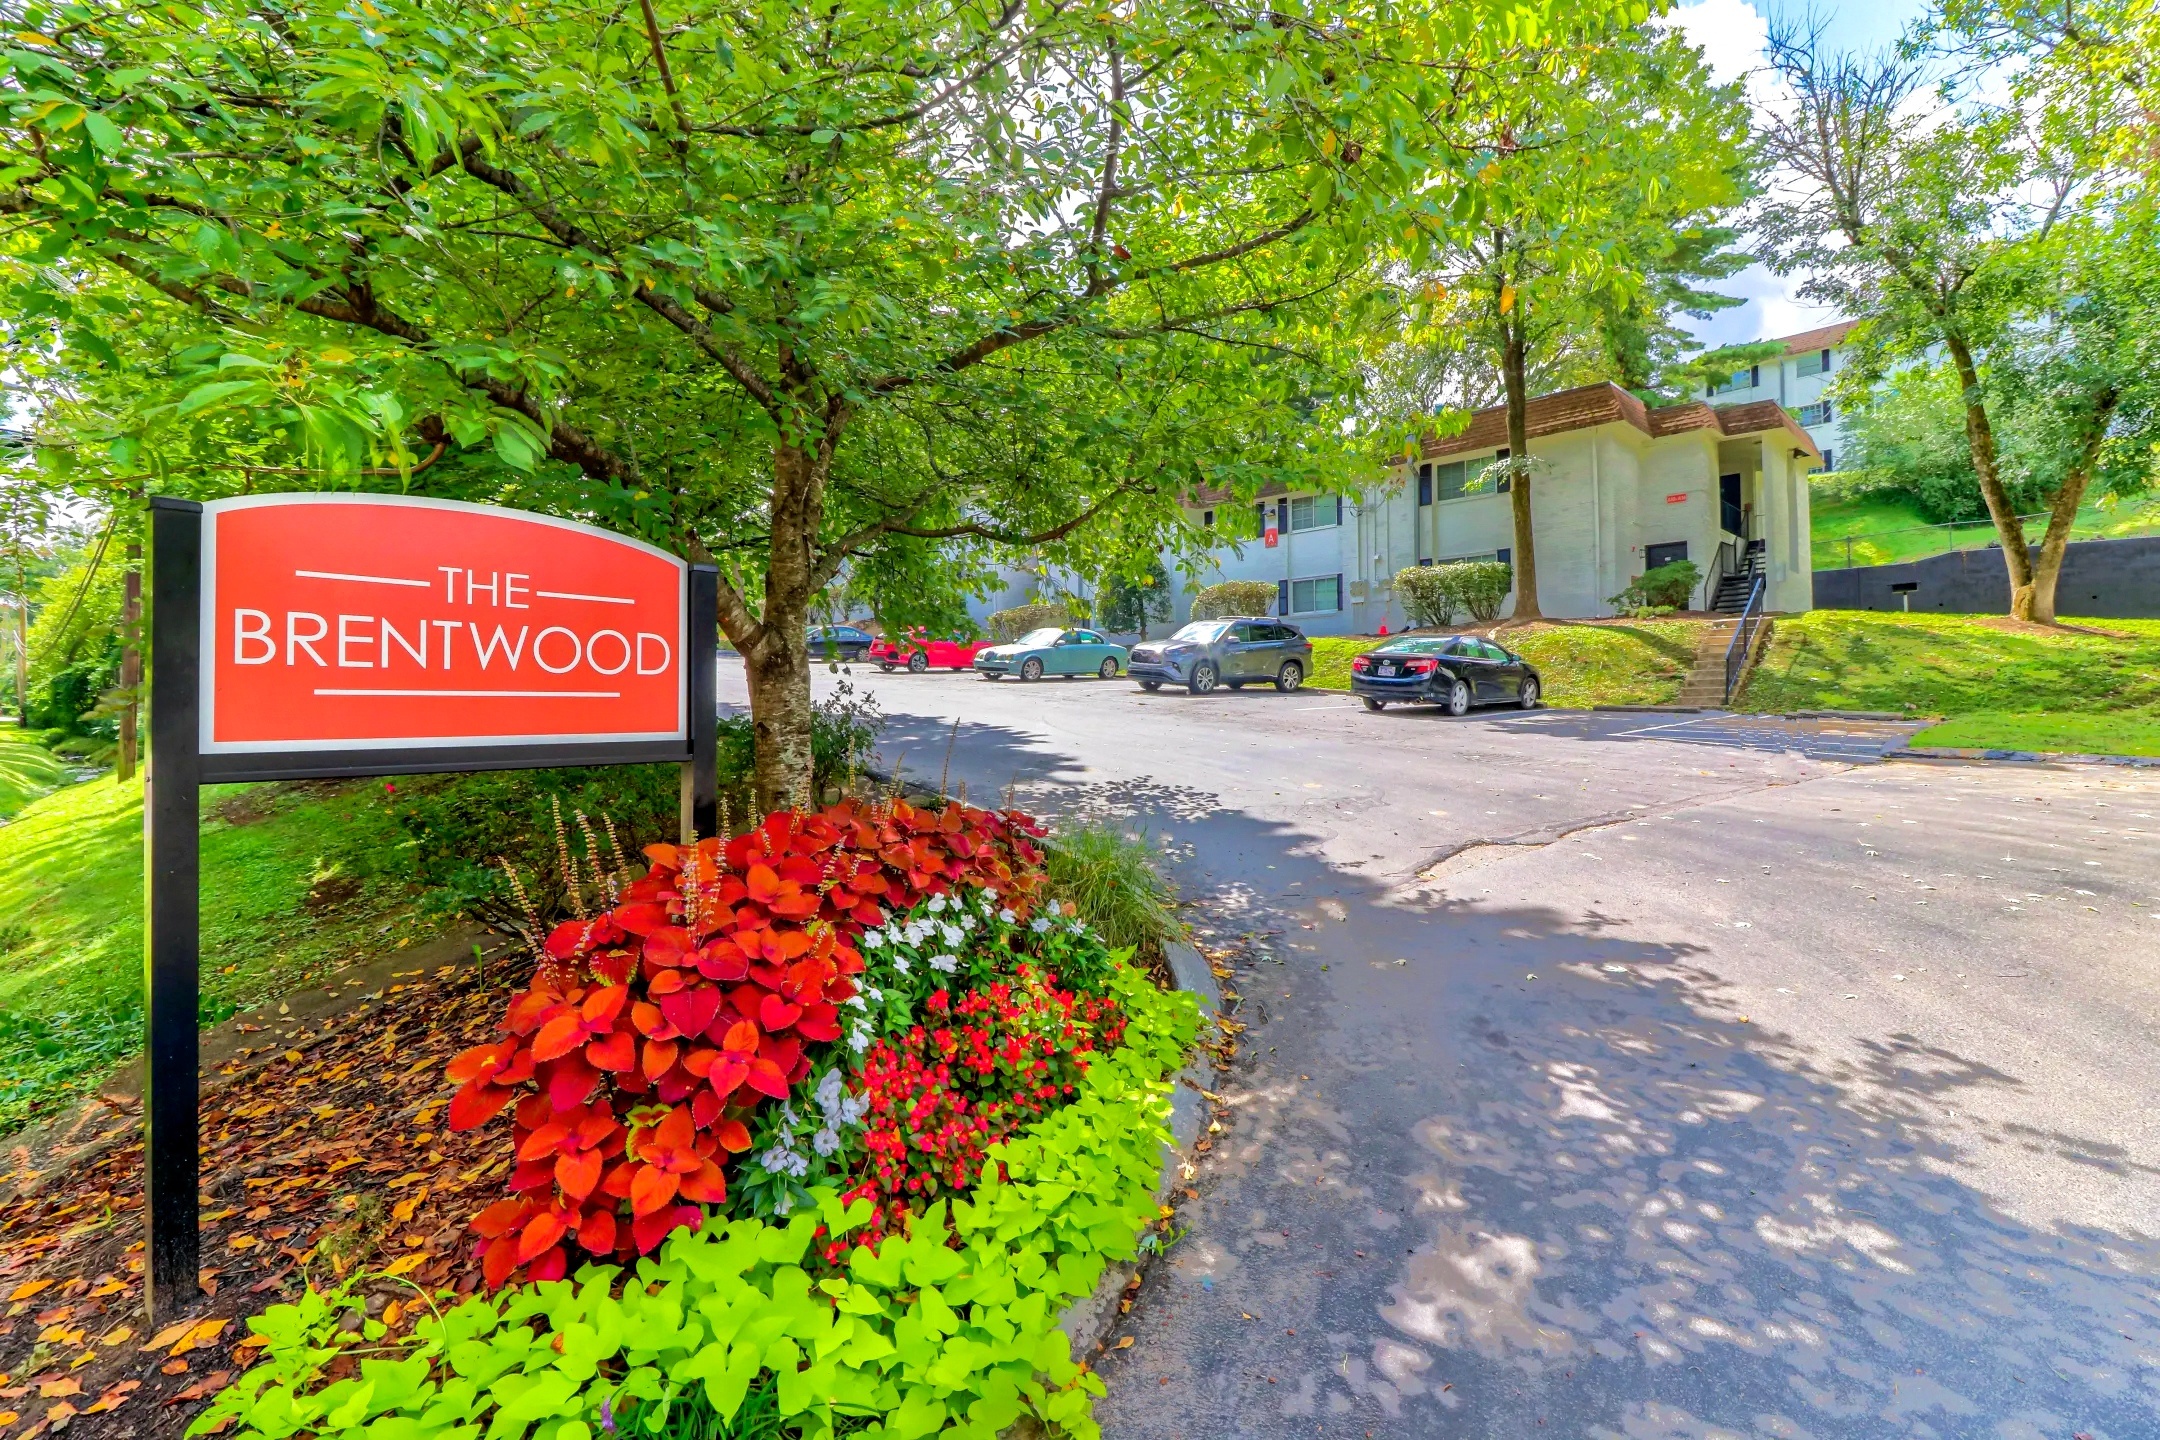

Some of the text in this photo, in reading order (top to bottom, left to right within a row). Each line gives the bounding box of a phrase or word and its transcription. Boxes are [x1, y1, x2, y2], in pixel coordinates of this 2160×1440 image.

[1268, 534, 1275, 543] A
[437, 566, 530, 609] THE
[234, 608, 671, 675] BRENTWOOD
